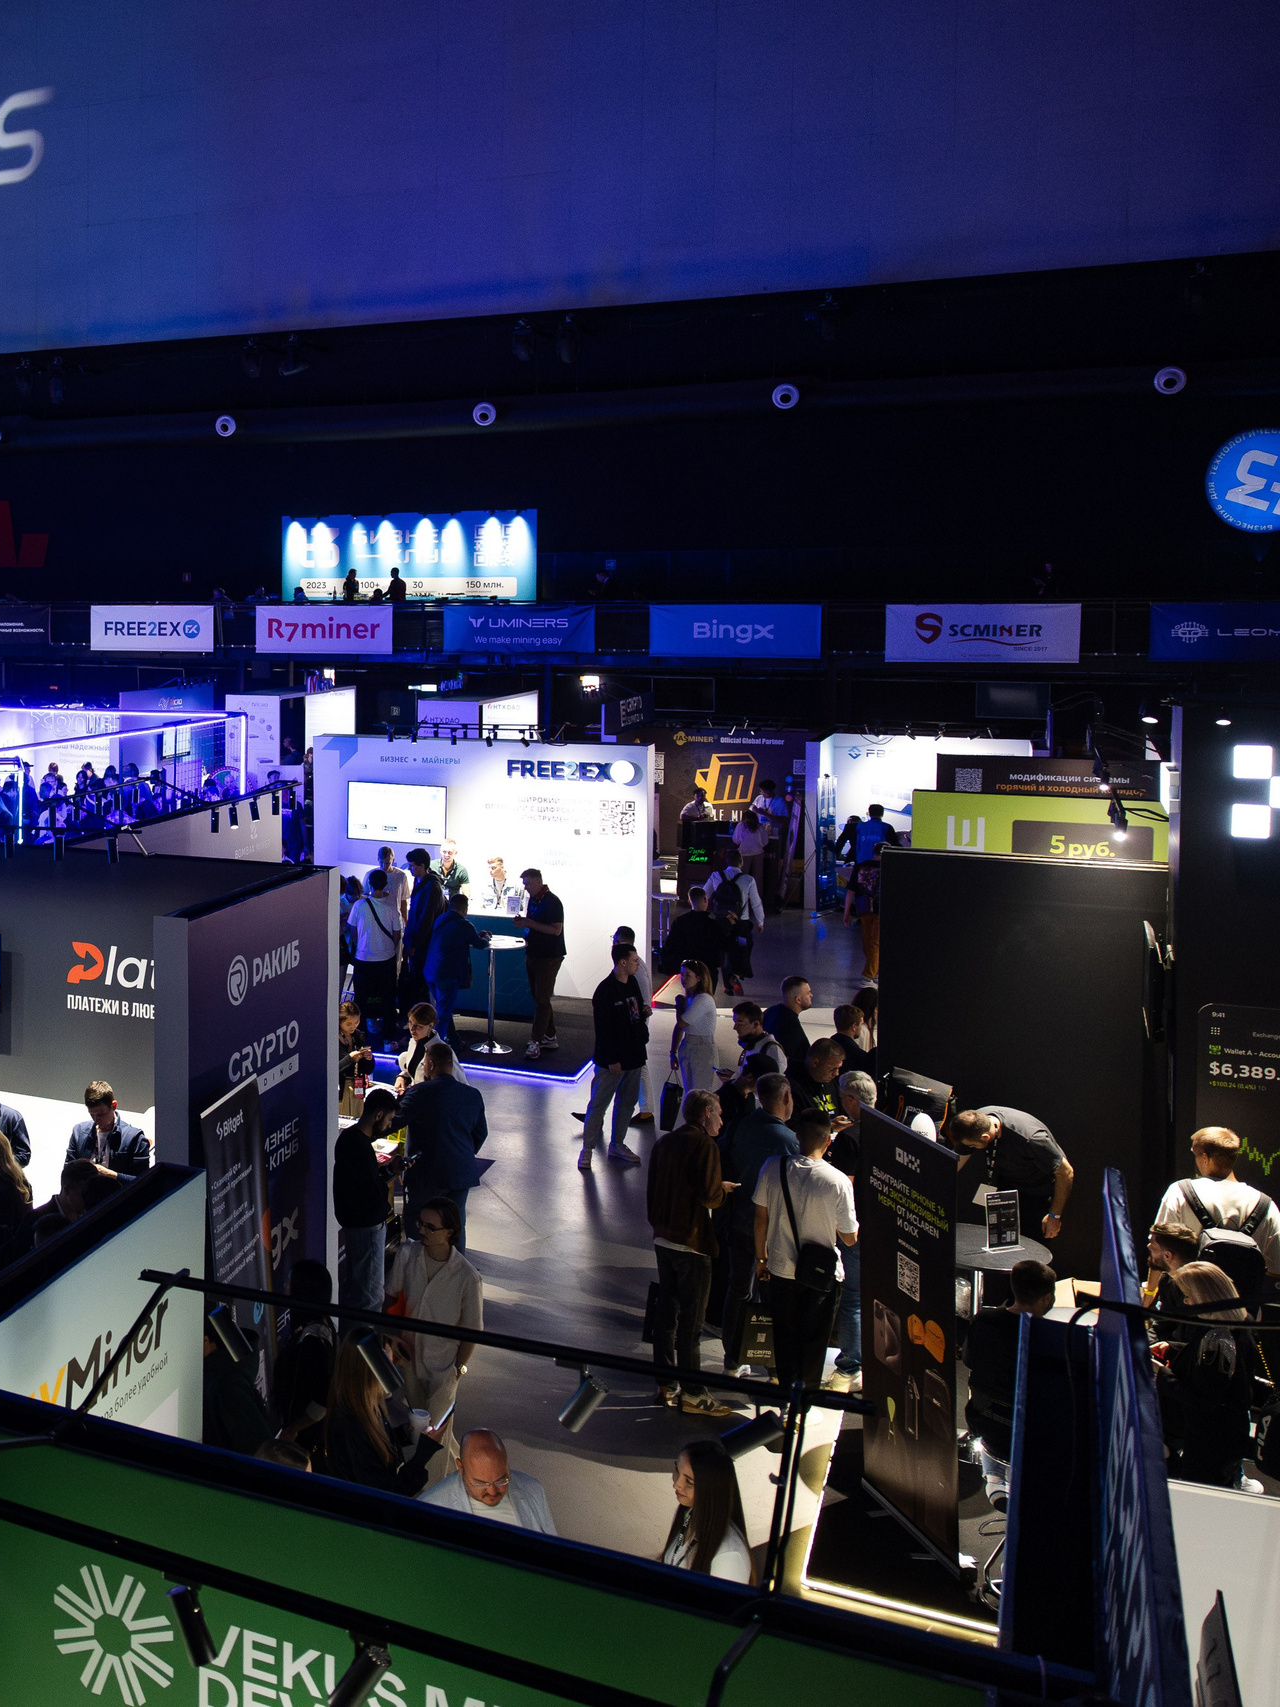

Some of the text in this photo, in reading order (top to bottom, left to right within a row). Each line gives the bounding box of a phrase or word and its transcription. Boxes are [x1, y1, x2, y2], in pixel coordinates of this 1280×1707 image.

[1209, 428, 1280, 475] ТЕХНОЛОГИЧЕС
[306, 581, 327, 589] 2023
[360, 581, 380, 589] 100+
[412, 581, 424, 589] 30
[466, 581, 482, 589] 150
[104, 621, 181, 637] FREE2EX
[267, 617, 381, 643] R7miner
[489, 617, 569, 629] UMINERS
[949, 624, 1043, 637] SCMINER
[474, 636, 562, 646] We make mining easy
[673, 734, 714, 743] JASMINER
[720, 735, 785, 746] Official Global Partner
[380, 755, 461, 765] БИЗНЕС МАЙНЕРЫ
[506, 759, 611, 782] FREE2EX
[1009, 773, 1130, 785] модификации сисемы
[995, 783, 1098, 795] горячий и холодный
[1049, 835, 1116, 860] 5 руб.
[252, 939, 300, 987] РАКИБ
[67, 994, 120, 1015] ПЛАТЕЖИ
[122, 1002, 129, 1016] В
[228, 1020, 300, 1083] CRYPTO
[1223, 1047, 1246, 1056] Wallet
[222, 1108, 244, 1138] Bitget
[264, 1117, 299, 1153] ИЗНЕС
[269, 1137, 299, 1171] КЛУБ
[895, 1147, 920, 1174] OKX
[872, 1165, 910, 1196] ВЫИГРАЙТЕ
[877, 1193, 896, 1211] МЕРЧ
[906, 1211, 940, 1239] MCLAREN
[889, 1188, 949, 1232] ЭКСКЛЮЗИВНЫЙ
